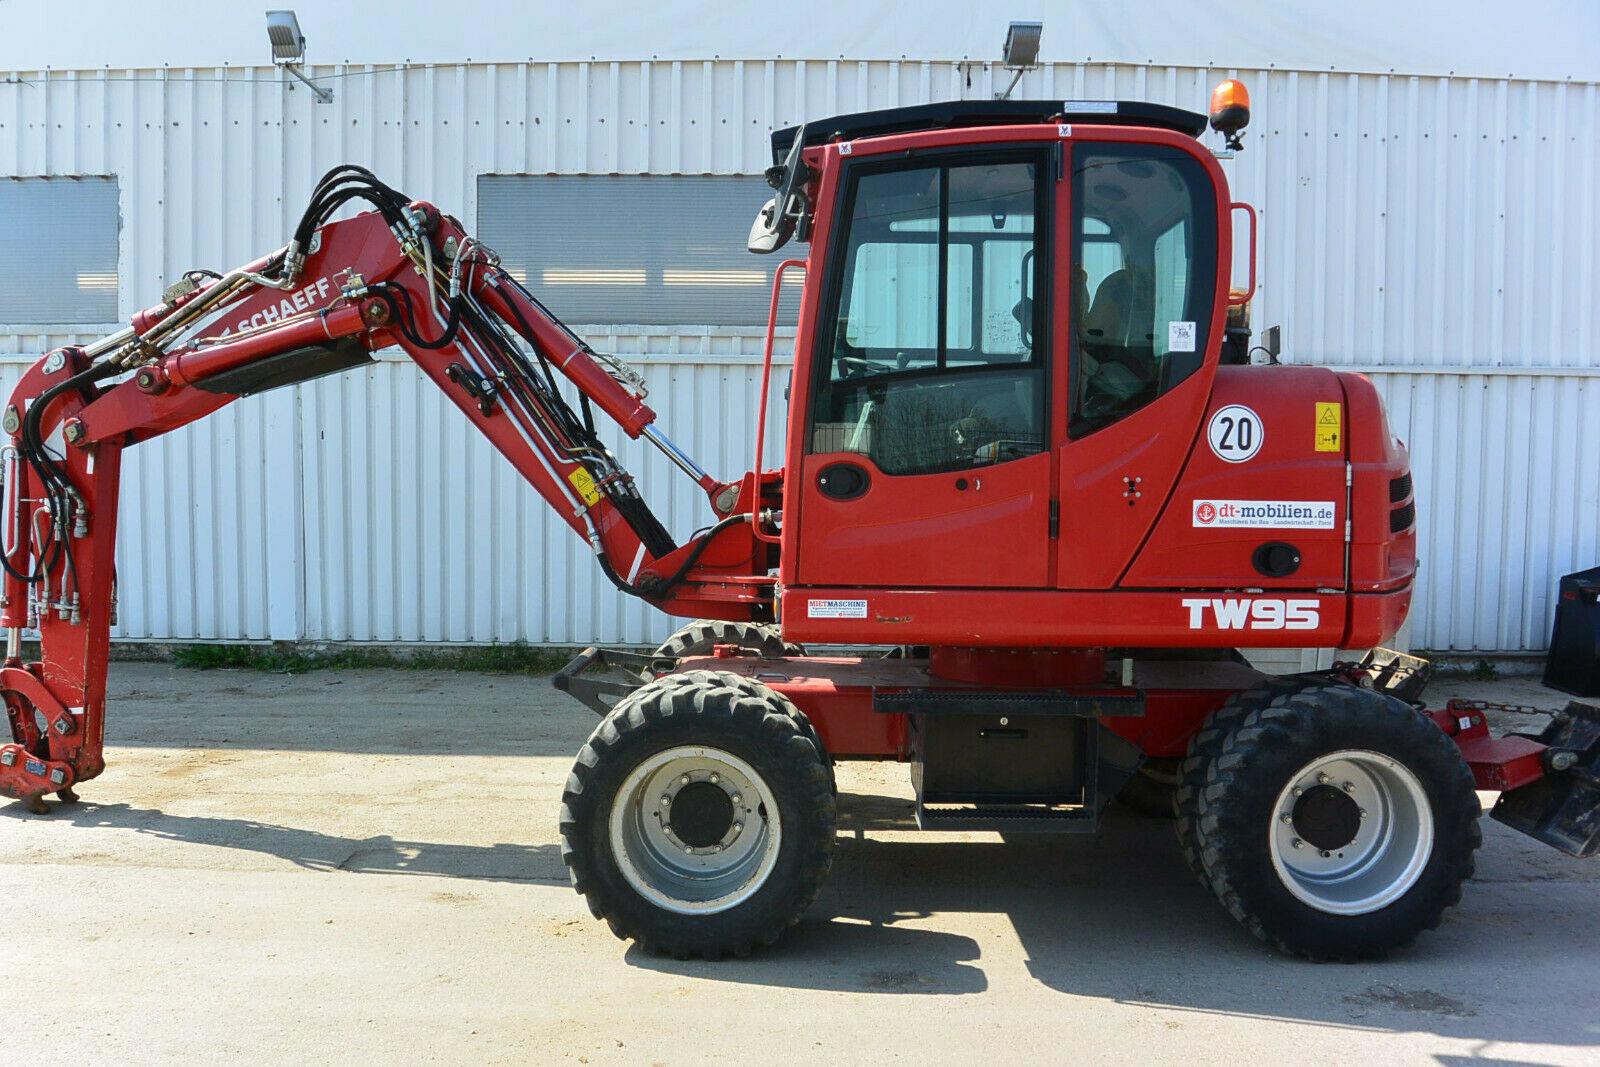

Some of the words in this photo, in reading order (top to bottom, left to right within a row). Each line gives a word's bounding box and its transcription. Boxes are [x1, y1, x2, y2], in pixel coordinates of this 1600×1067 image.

[237, 276, 330, 333] SCHAEFF
[1219, 416, 1252, 451] 20
[1218, 503, 1333, 519] dt-mobilien.de
[809, 600, 866, 608] MIETMASCHINE
[1181, 598, 1320, 630] TW95
